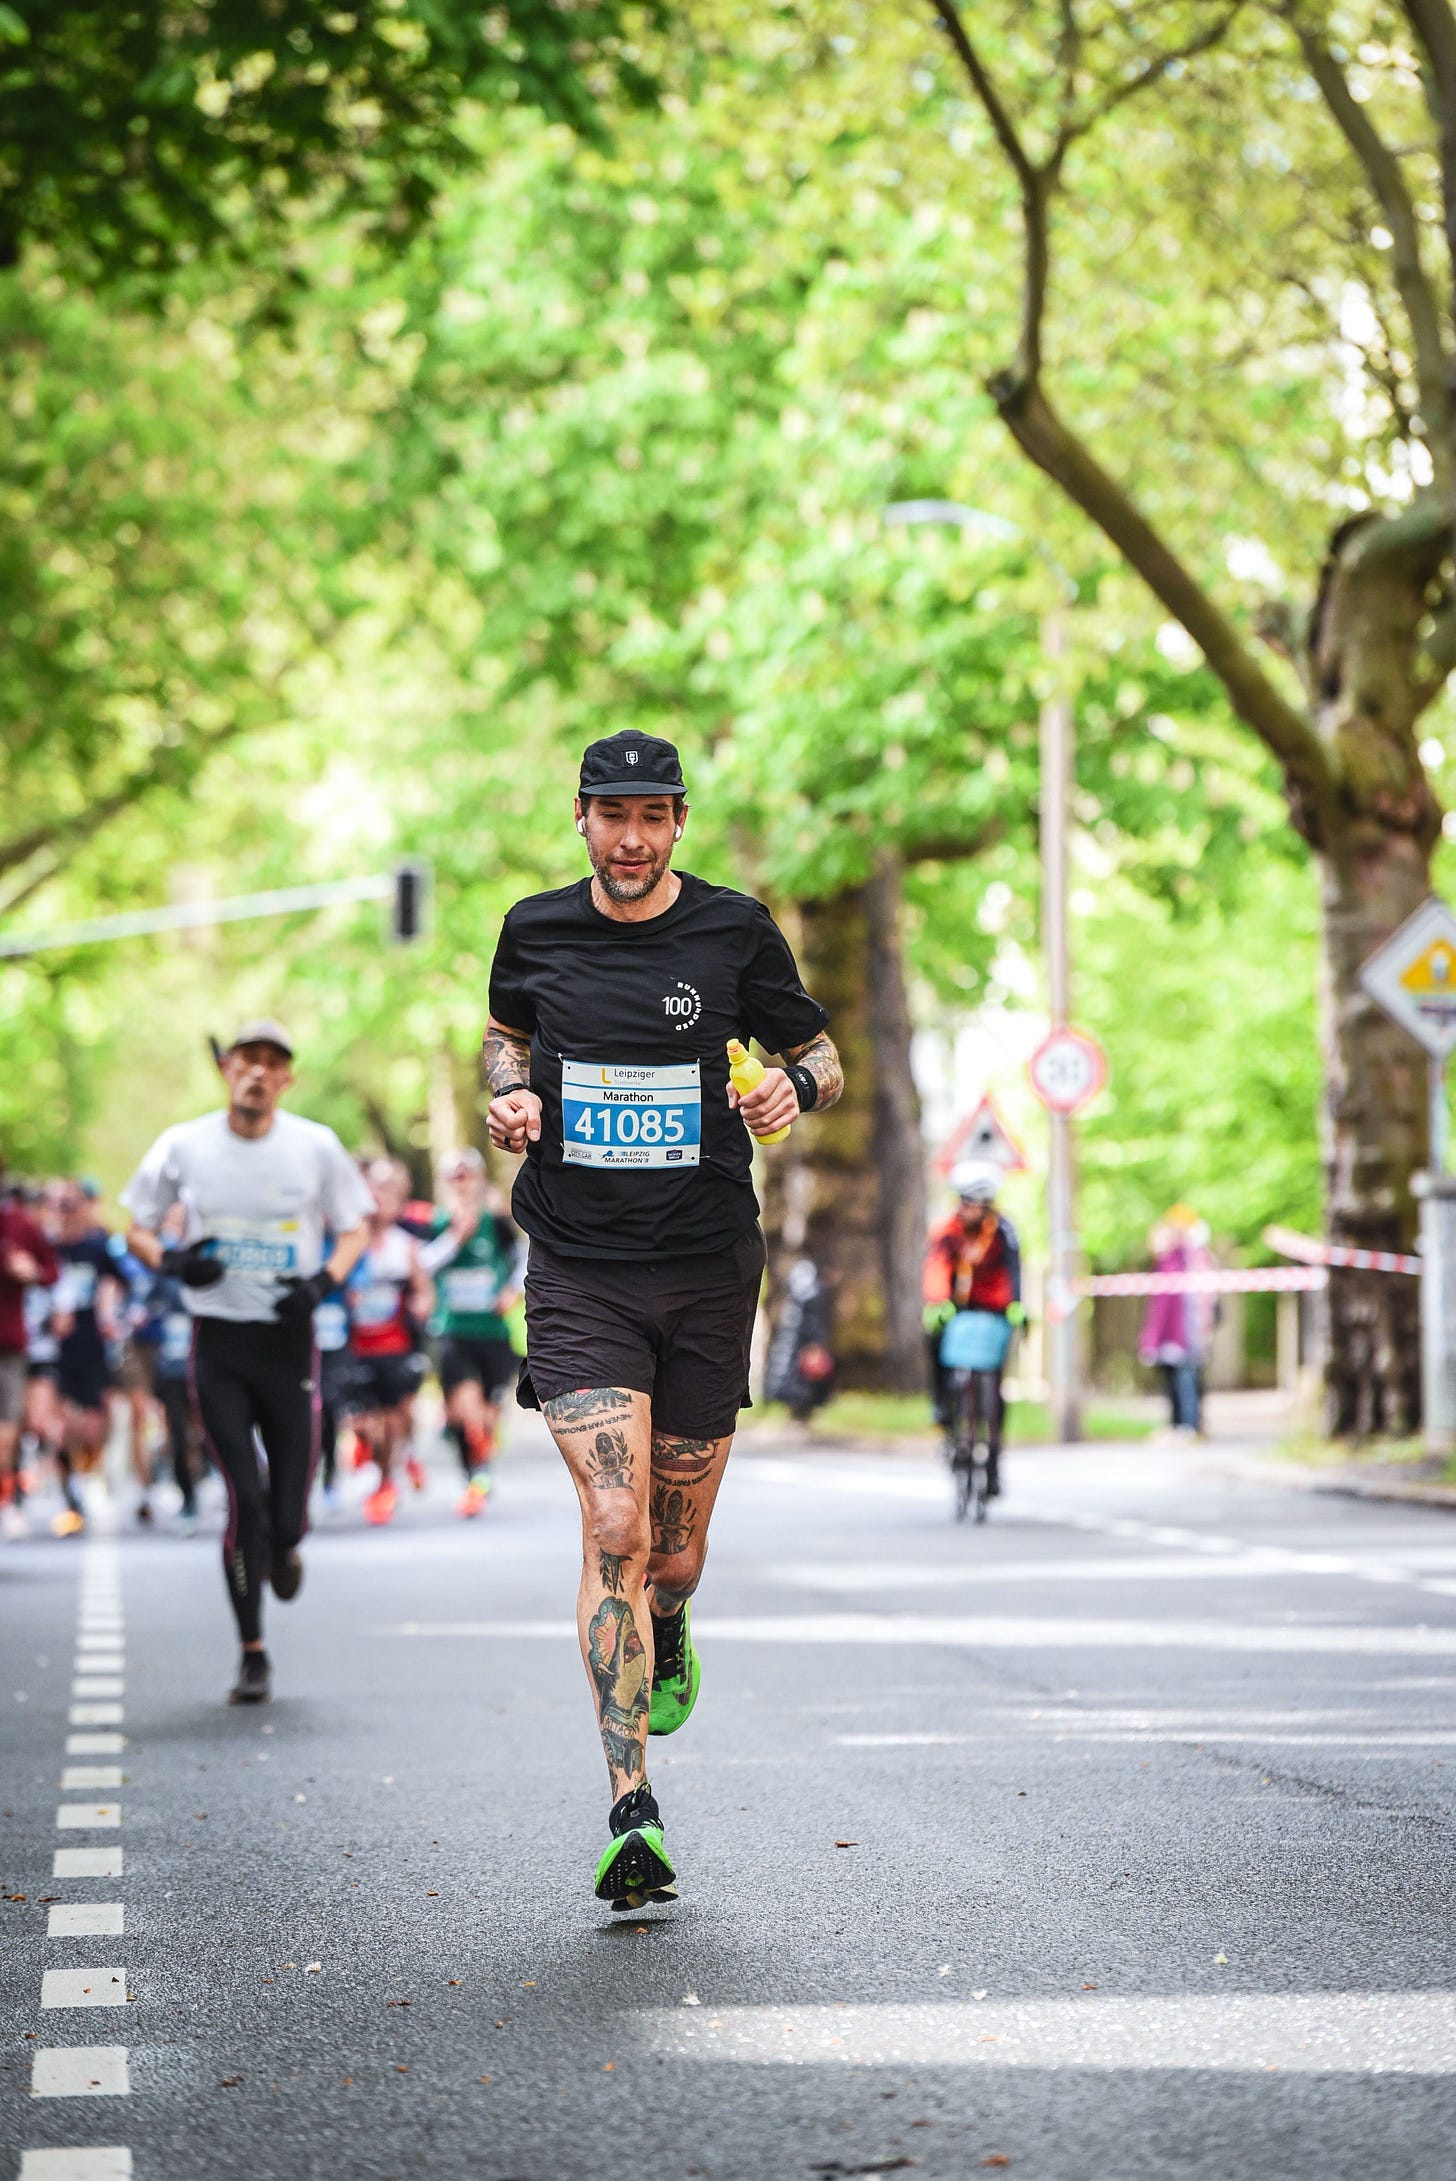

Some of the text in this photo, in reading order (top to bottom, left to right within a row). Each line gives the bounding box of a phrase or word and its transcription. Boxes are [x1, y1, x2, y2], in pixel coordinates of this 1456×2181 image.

[661, 996, 692, 1016] 100
[614, 1069, 655, 1080] Leipziger
[603, 1091, 654, 1102] Marathon
[574, 1107, 685, 1143] 41085
[588, 1421, 605, 1431] FAR
